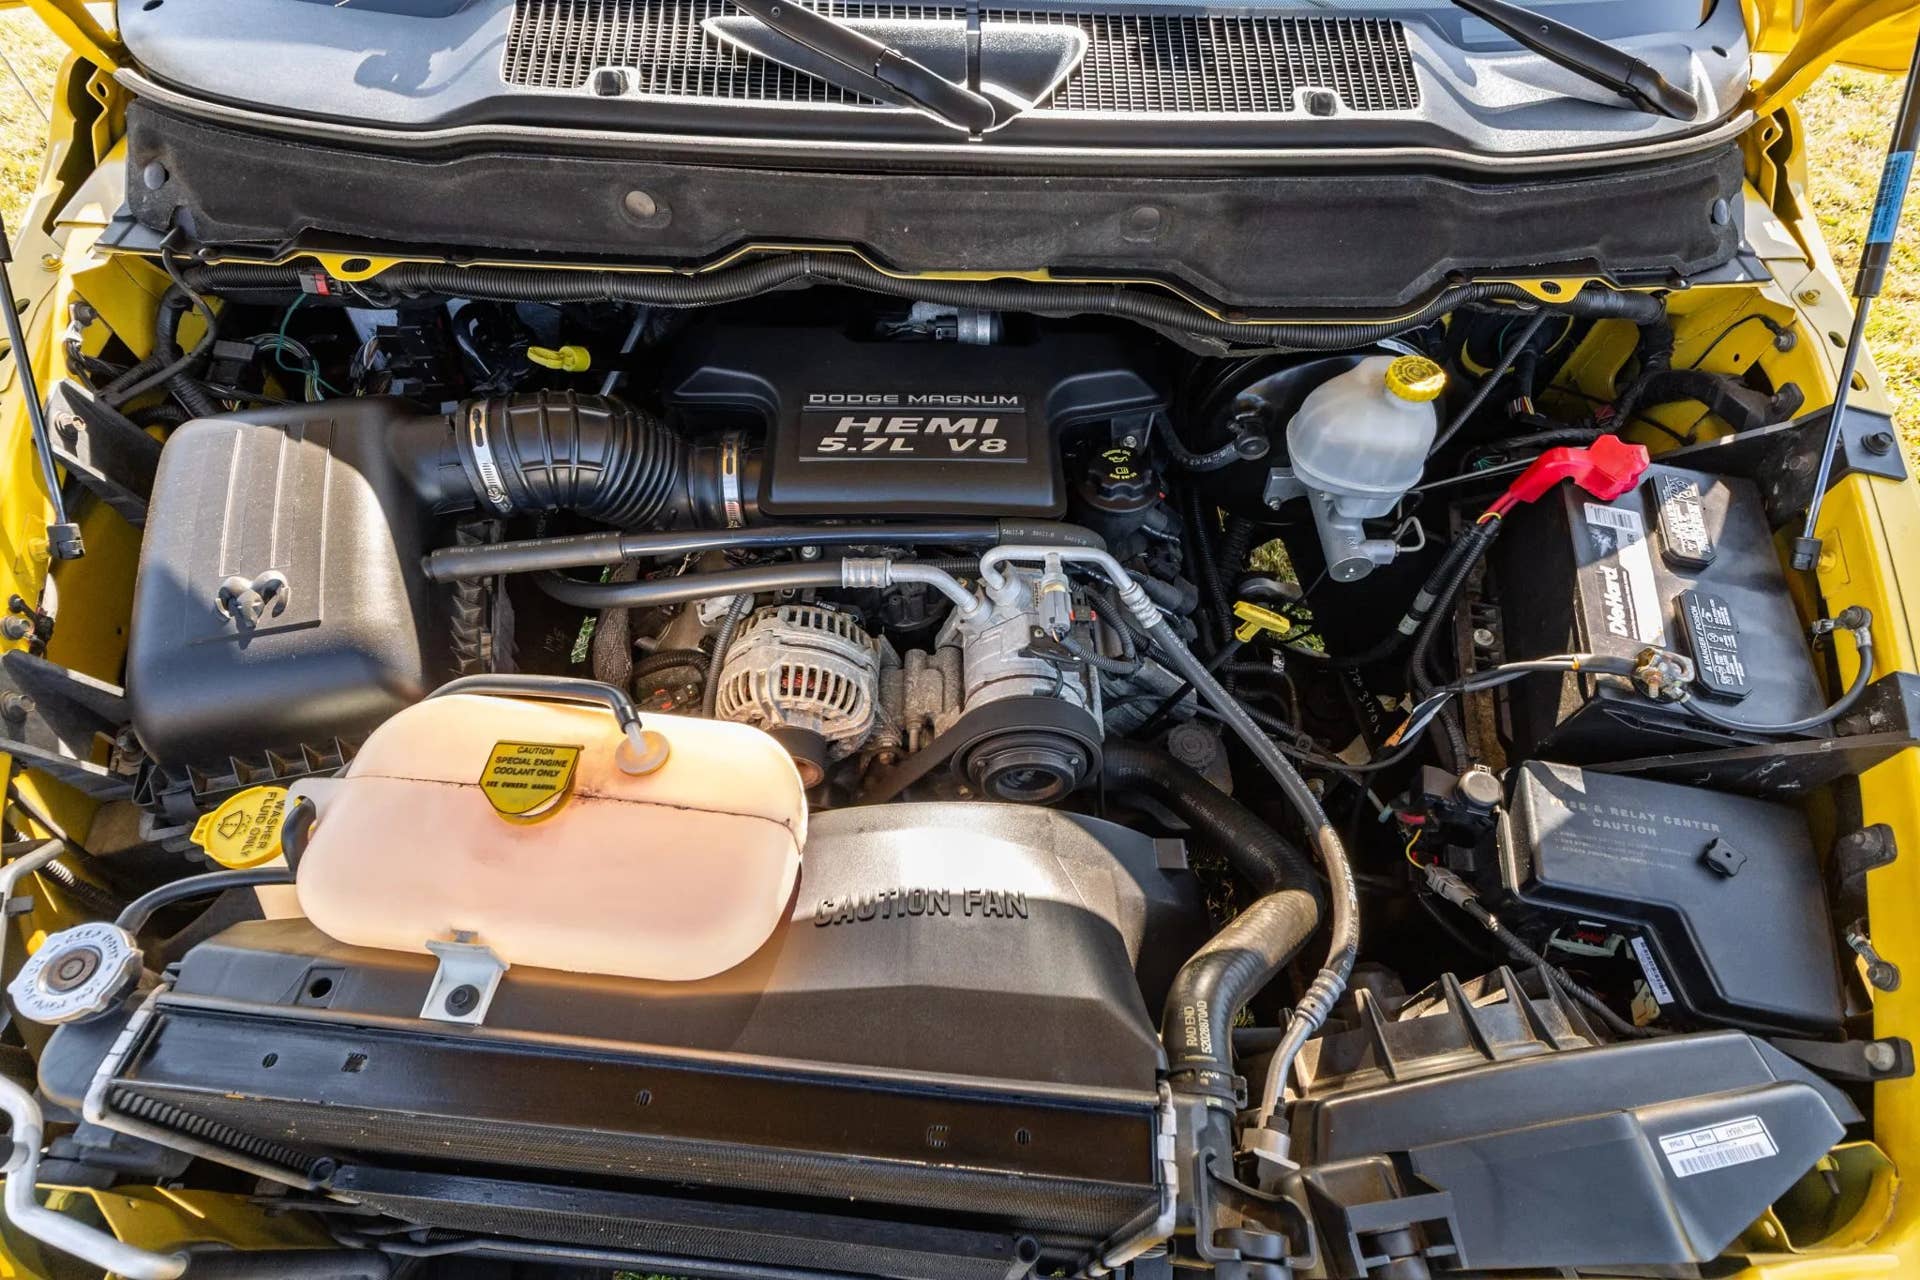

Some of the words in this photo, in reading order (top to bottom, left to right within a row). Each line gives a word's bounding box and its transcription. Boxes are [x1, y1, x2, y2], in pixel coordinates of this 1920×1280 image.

[809, 394, 899, 404] DODGE
[908, 394, 1018, 405] MAGNUM
[834, 416, 999, 434] HEMI
[817, 437, 914, 452] 5.7L
[948, 438, 1008, 453] V8
[1595, 565, 1628, 637] DieHard
[1690, 606, 1702, 627] POISON
[1698, 632, 1712, 665] DANGER
[517, 746, 555, 755] CAUTION
[493, 767, 536, 776] COOLANT
[536, 768, 560, 777] ONLY
[495, 756, 531, 766] SPECIAL
[533, 758, 569, 768] ENGINE
[255, 792, 277, 823] FLUID
[257, 800, 285, 849] WASHER
[1593, 818, 1657, 837] CAUTION
[1611, 807, 1656, 821] RELAY
[1664, 815, 1721, 833] CENTER
[240, 827, 260, 857] ONLY
[815, 886, 950, 927] CAUTION
[963, 887, 1029, 919] FAN
[1184, 1005, 1196, 1025] END
[1185, 1026, 1198, 1047] RAD
